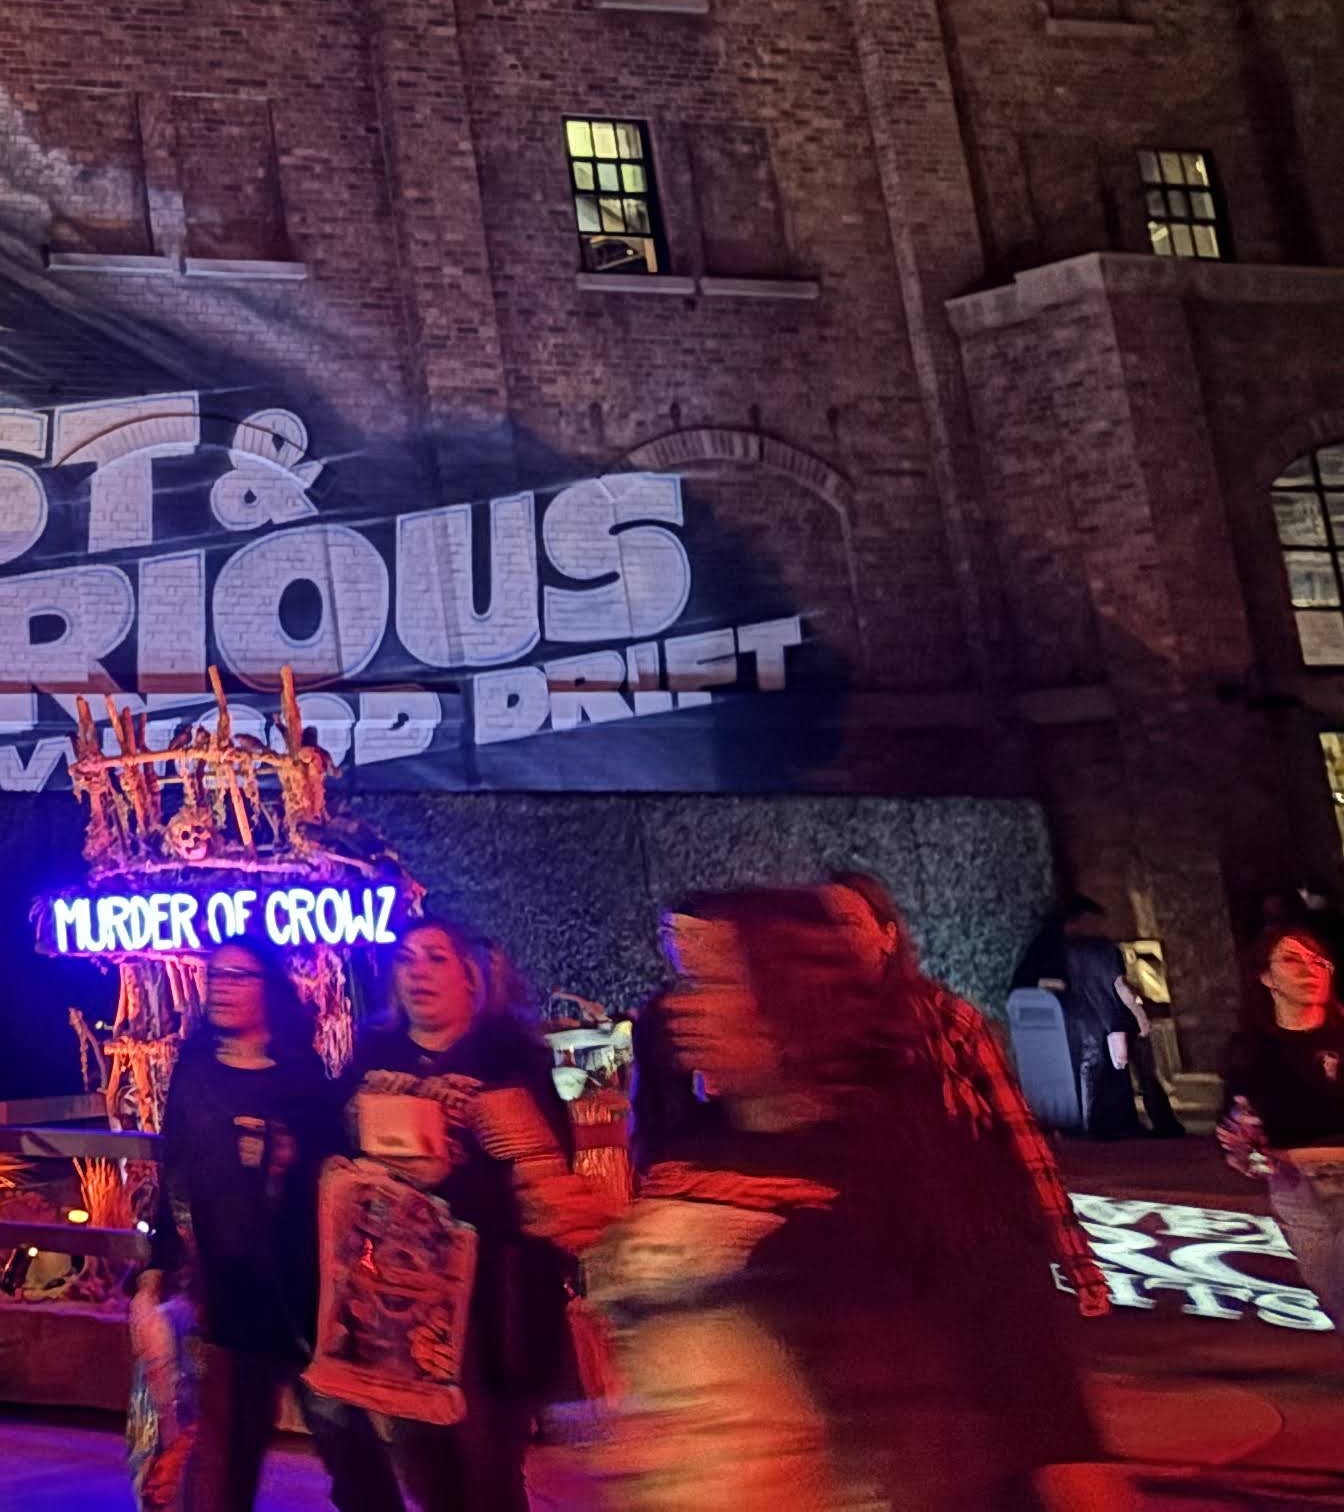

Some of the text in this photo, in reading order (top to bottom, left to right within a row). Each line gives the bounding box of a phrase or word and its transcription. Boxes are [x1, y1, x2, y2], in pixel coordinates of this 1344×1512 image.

[210, 407, 323, 532] &
[53, 885, 398, 954] MURDER OF CROWZ
